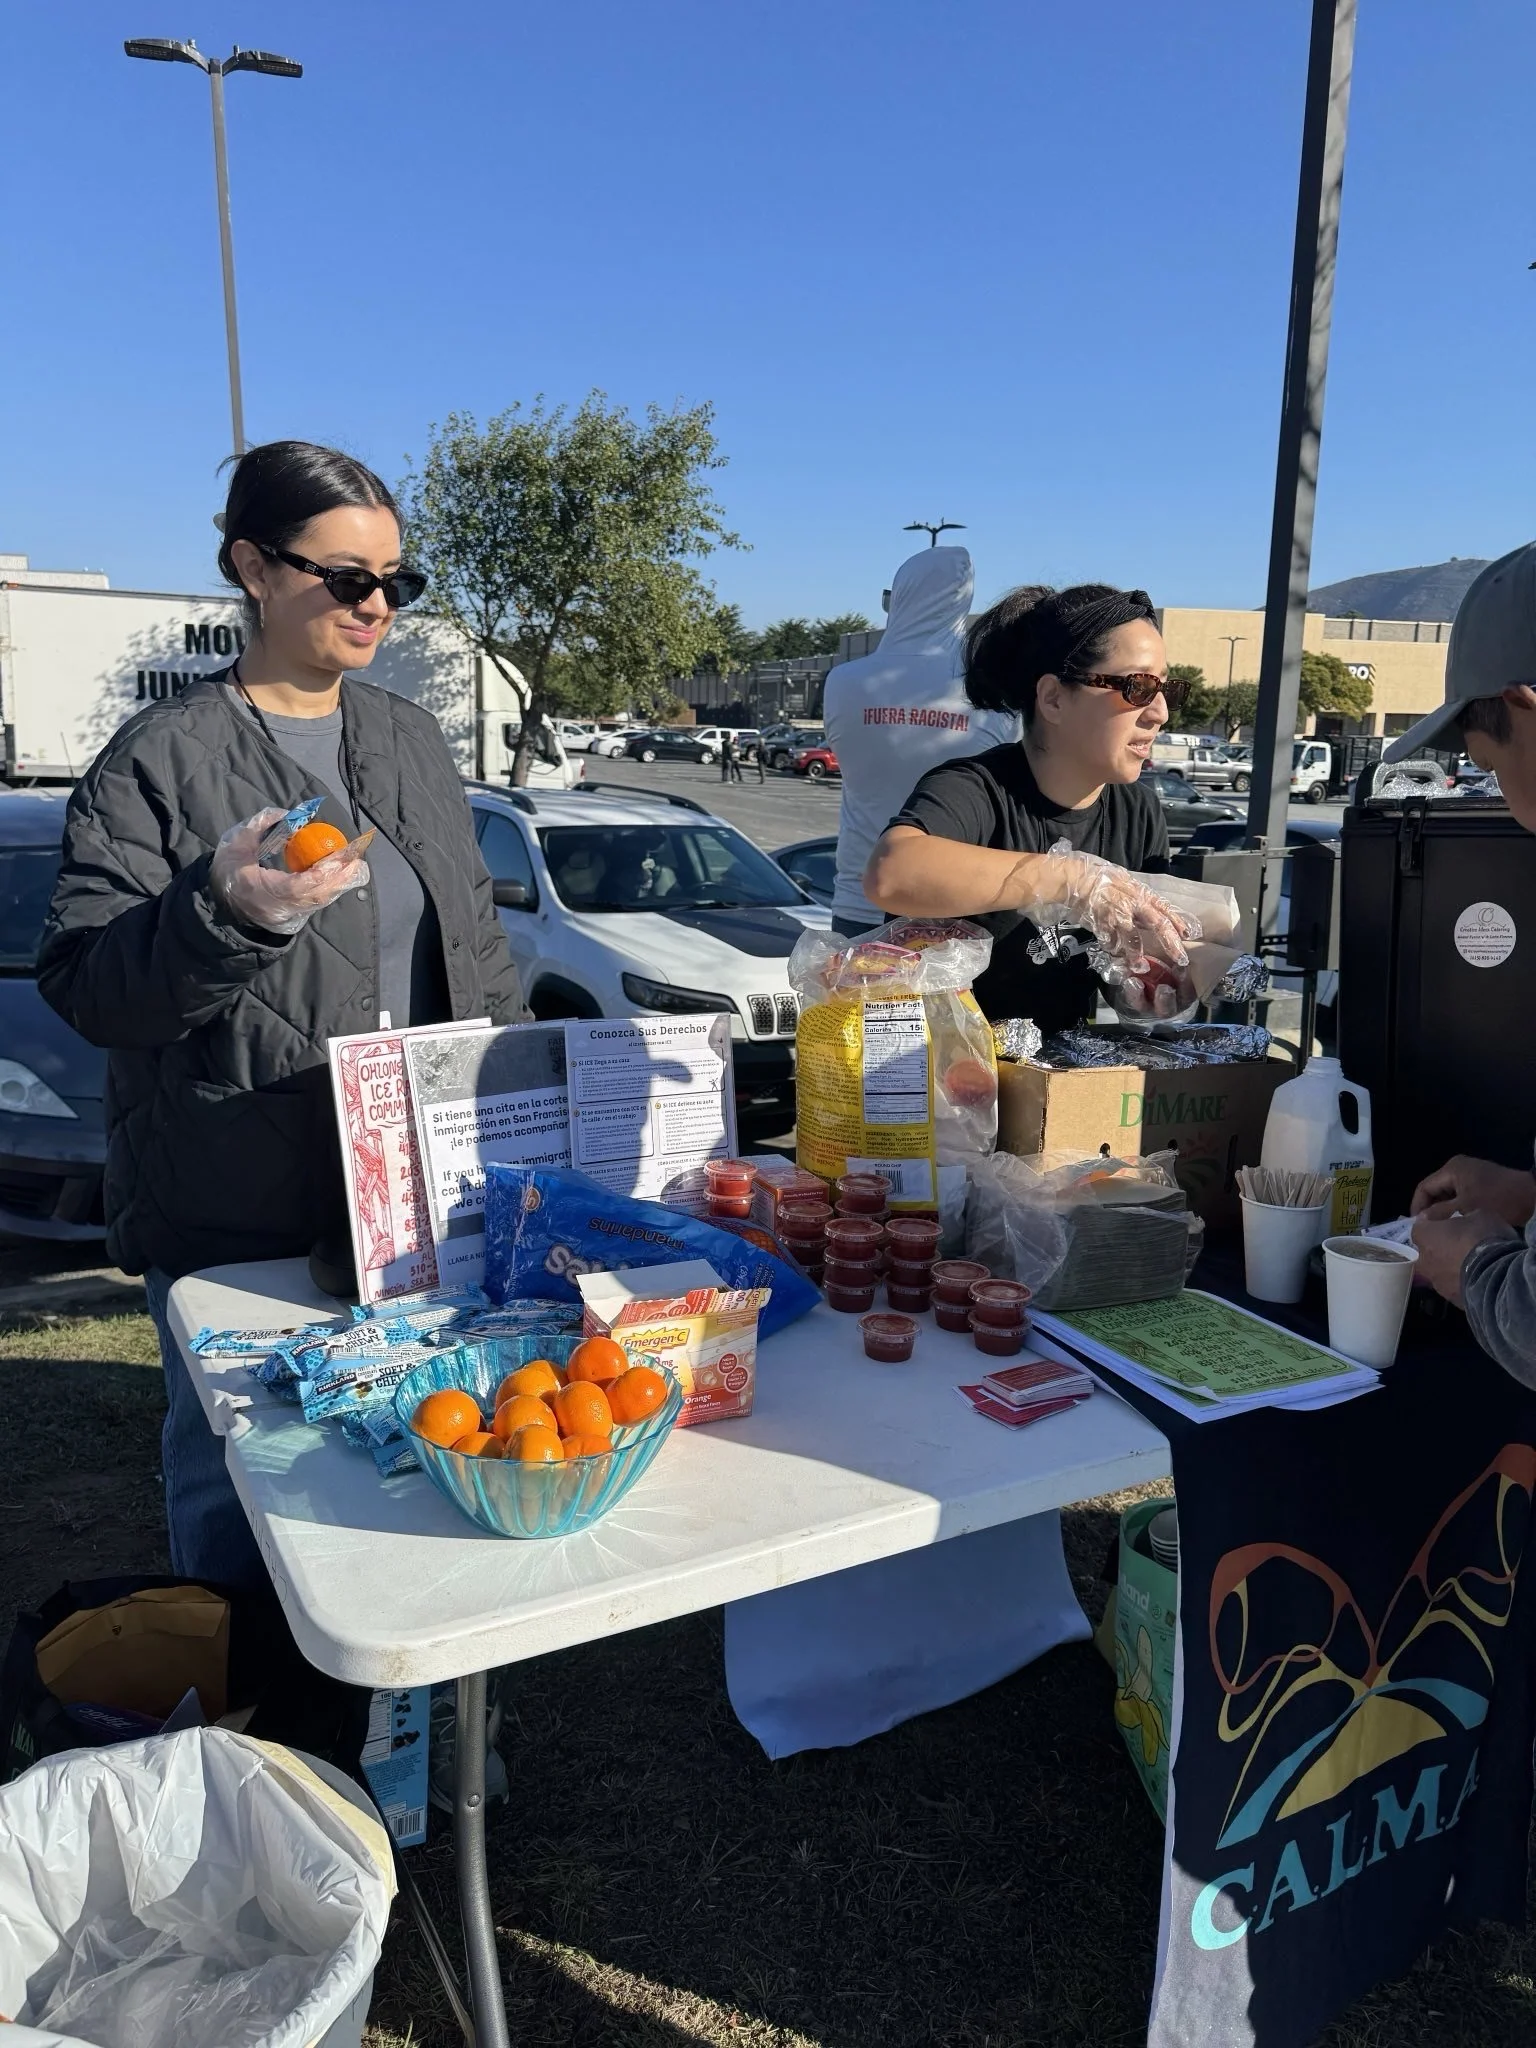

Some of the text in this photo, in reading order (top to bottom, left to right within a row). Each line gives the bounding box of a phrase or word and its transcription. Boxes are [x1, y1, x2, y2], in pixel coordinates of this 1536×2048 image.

[136, 671, 211, 701] JUN
[864, 707, 969, 732] ¡FUERA RACISTA!
[590, 1024, 707, 1040] Conozca Sus Derechos
[361, 1060, 404, 1082] OHLONE
[371, 1082, 392, 1102] ICE
[433, 1095, 568, 1123] Si tiene una cita en la corte
[434, 1117, 497, 1137] inmigración
[498, 1116, 511, 1126] en
[513, 1112, 532, 1125] San
[466, 1130, 513, 1147] podemos
[514, 1120, 569, 1137] acompañar
[443, 1171, 453, 1182] If
[454, 1167, 474, 1183] you
[441, 1183, 472, 1197] court
[454, 1198, 473, 1209] We
[589, 1217, 685, 1251] mandarins
[447, 1254, 469, 1266] LLAME
[292, 1339, 325, 1355] KIRKLAND
[344, 1329, 368, 1341] SOFT
[346, 1334, 381, 1350] CHEWY
[318, 1374, 355, 1392] KIRKLAND
[379, 1365, 405, 1378] SOFT
[685, 1394, 712, 1404] Orange
